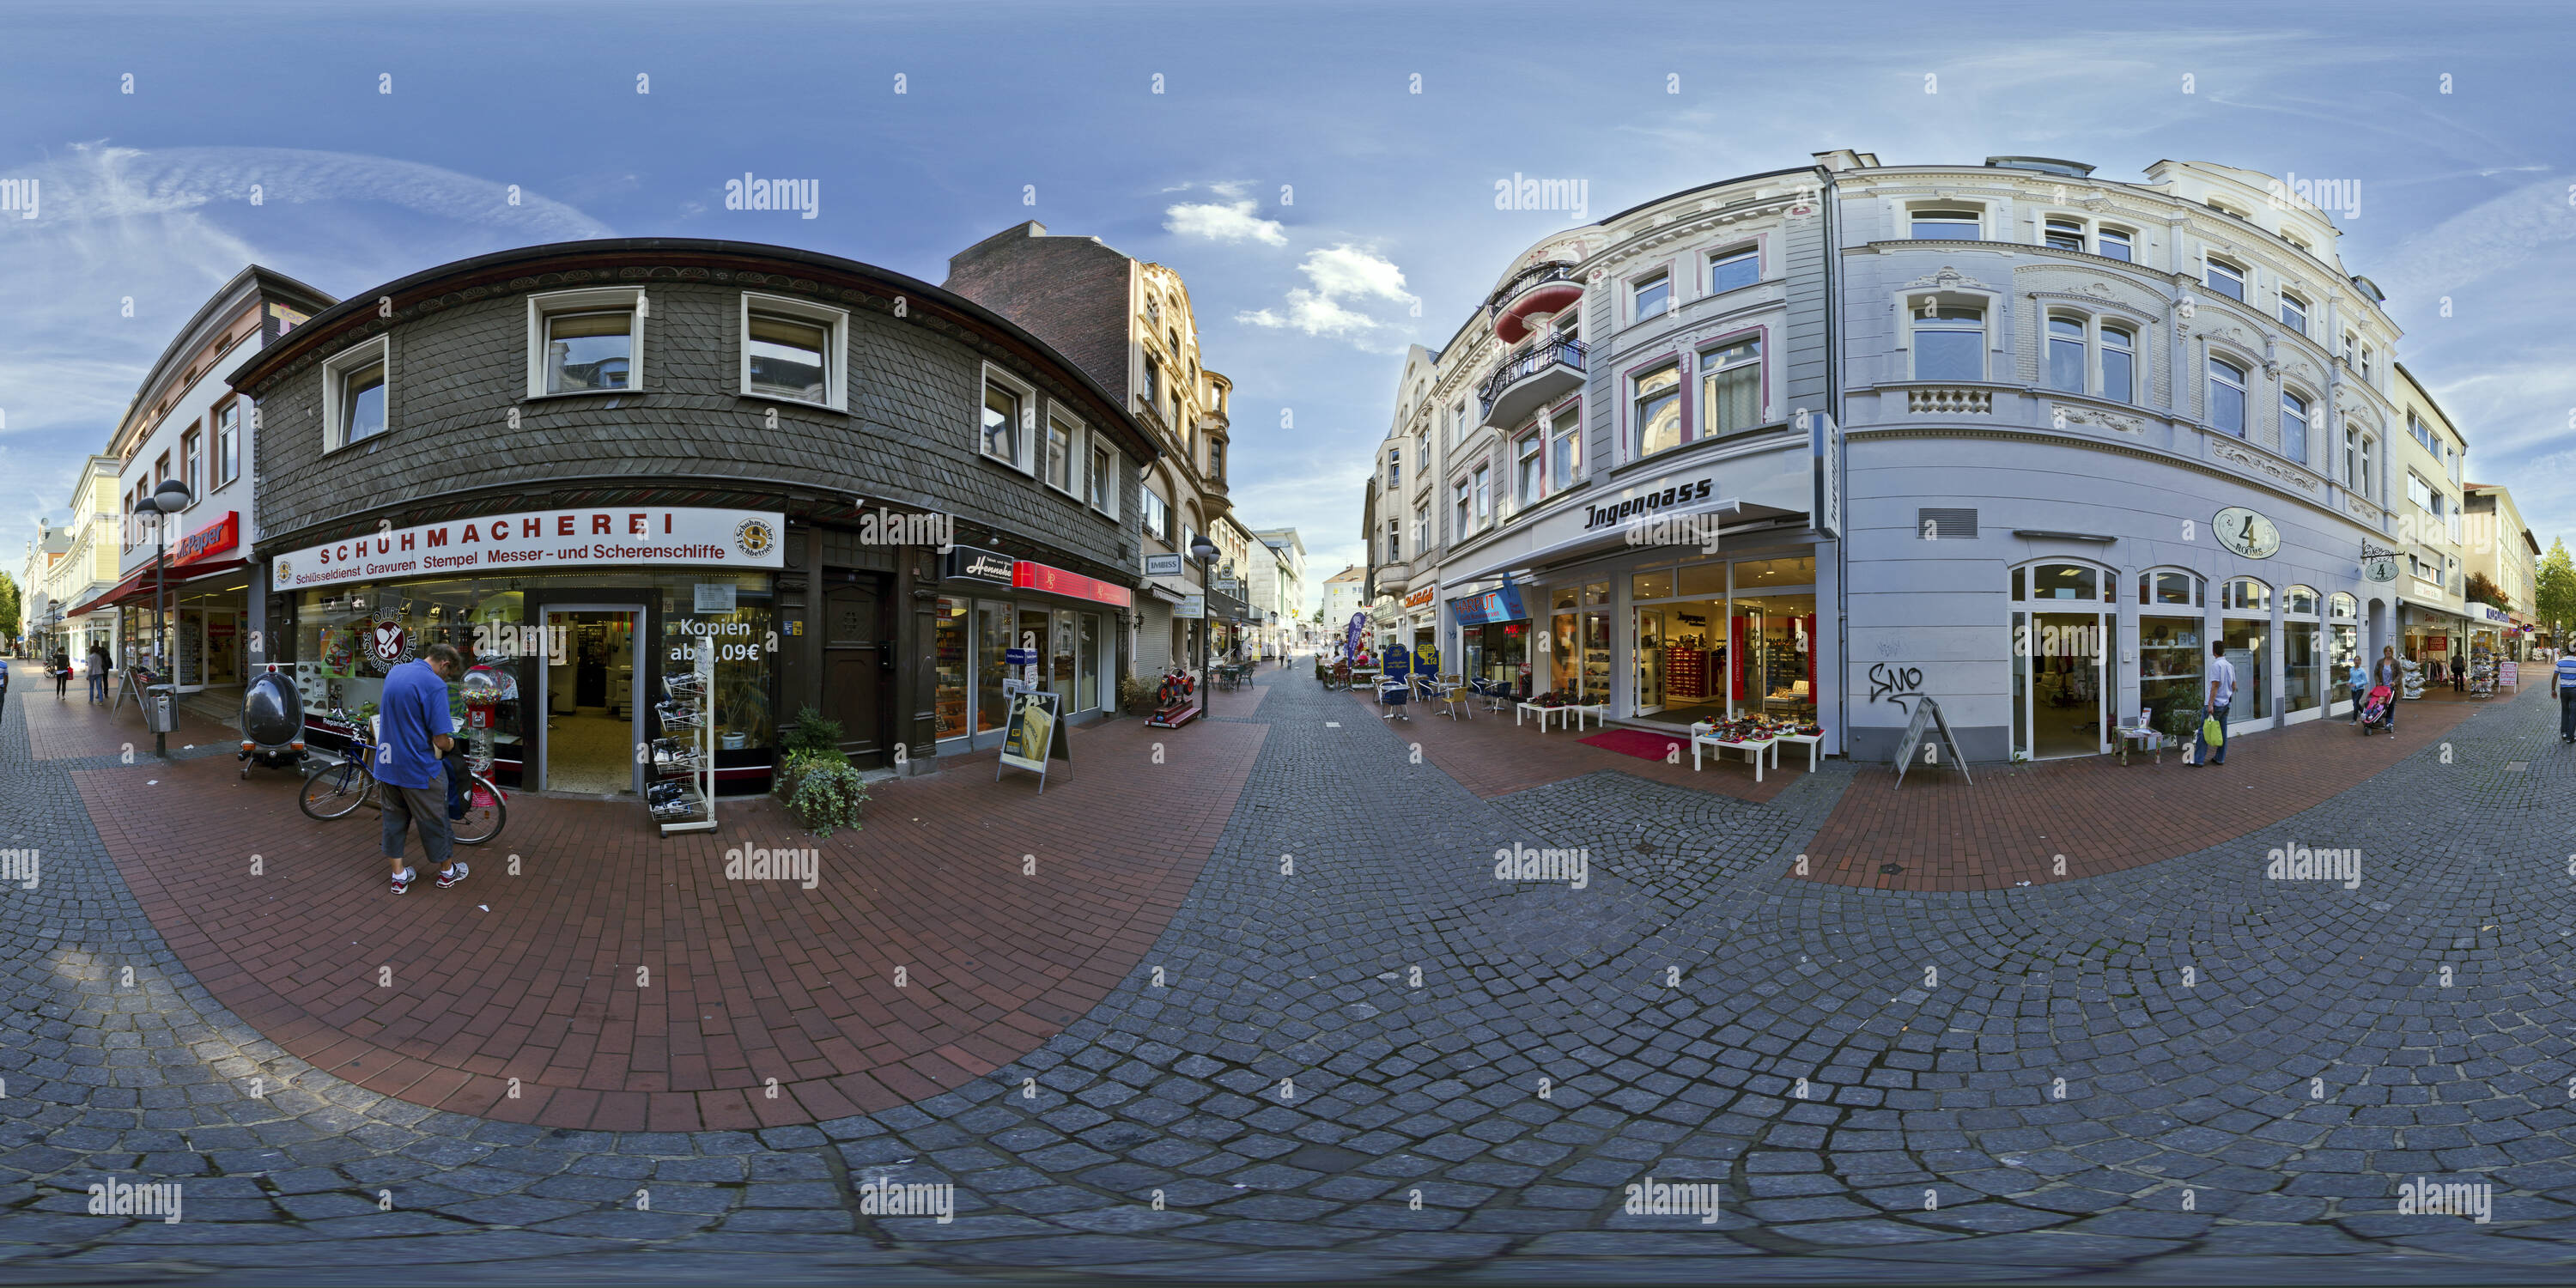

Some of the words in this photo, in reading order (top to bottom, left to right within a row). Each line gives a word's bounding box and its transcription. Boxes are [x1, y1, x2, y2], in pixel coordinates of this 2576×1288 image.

[320, 513, 672, 564] SCHUHMACHEREI
[736, 519, 773, 540] Schuhmacher
[2239, 515, 2257, 548] 4
[176, 524, 223, 560] McPaper
[737, 540, 773, 556] Fachbetrieb
[2235, 543, 2263, 557] ROOMS
[296, 567, 361, 585] Schlüsseldienst
[367, 559, 416, 575] Gravuren
[423, 551, 478, 570] Stempel
[557, 545, 588, 559] und
[593, 544, 725, 559] Scherenschliffe
[966, 556, 1012, 578] Henneke
[1151, 561, 1177, 569] IMBISS
[2377, 563, 2385, 577] 4
[1455, 593, 1496, 615] HARPUT
[373, 606, 404, 623] Olli's
[680, 618, 750, 637] Kopien
[671, 643, 696, 660] ab
[714, 643, 760, 663] ,09€
